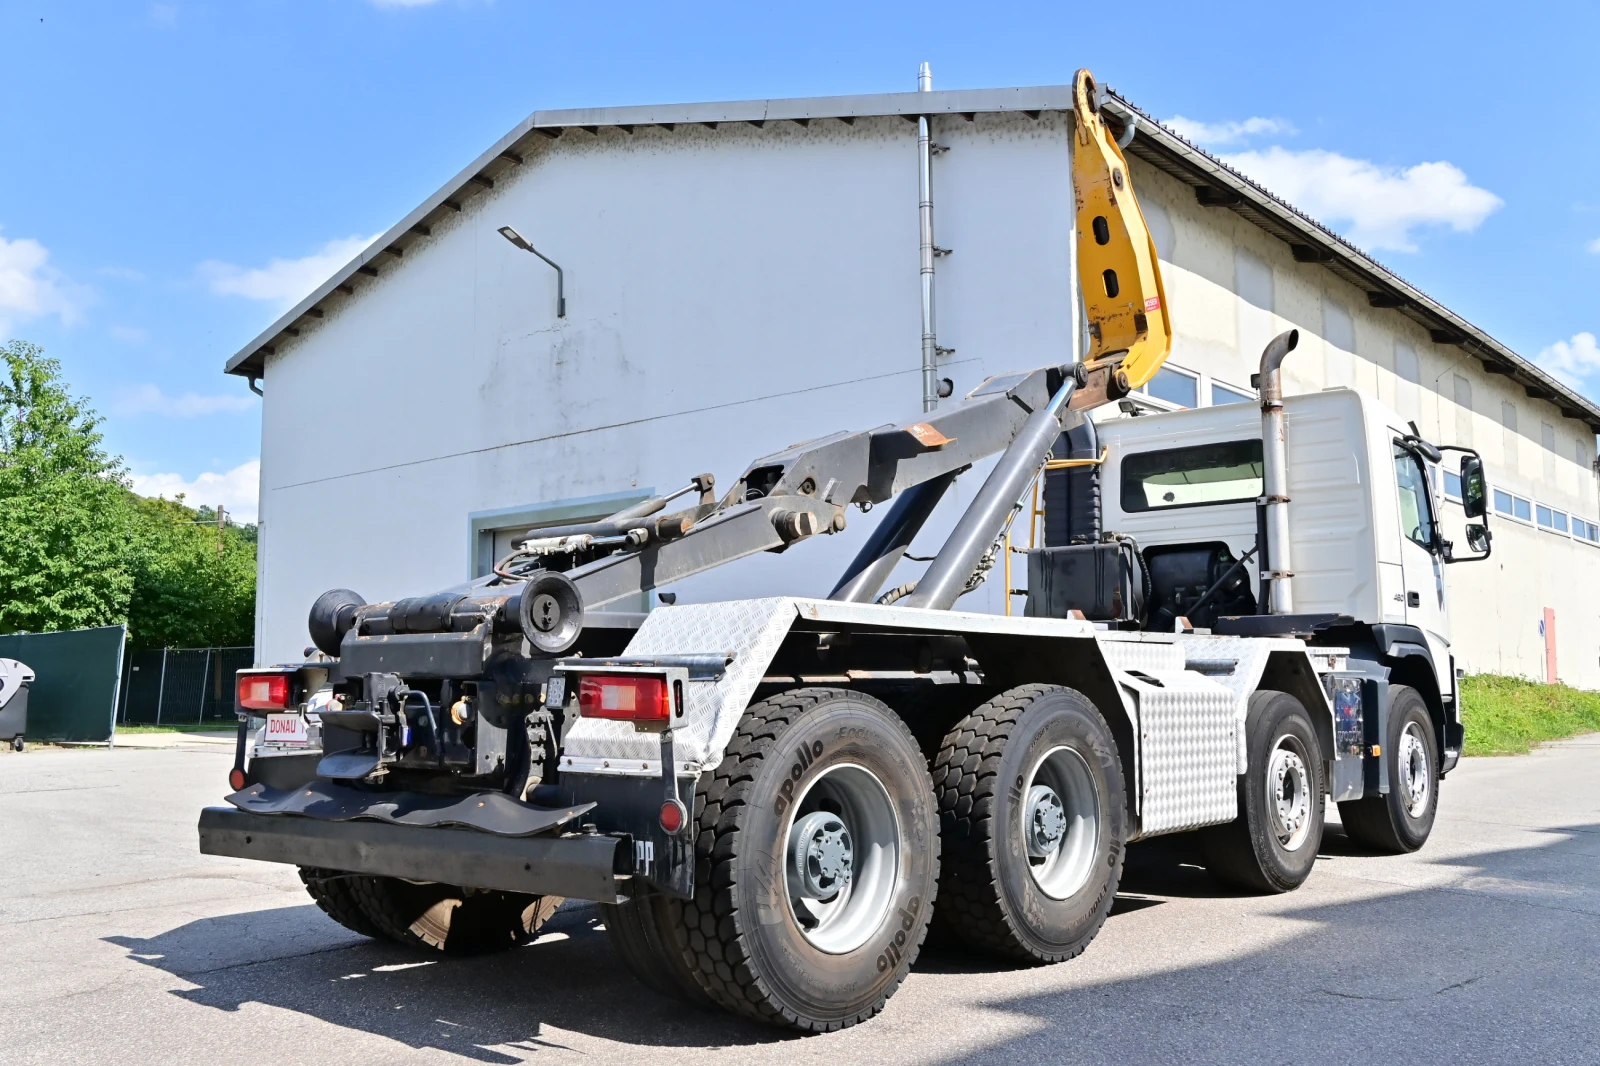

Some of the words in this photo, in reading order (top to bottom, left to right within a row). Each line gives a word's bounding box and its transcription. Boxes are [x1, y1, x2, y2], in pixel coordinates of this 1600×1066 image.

[269, 719, 297, 734] DONAU
[774, 739, 824, 816] apollo
[876, 895, 920, 973] apollo
